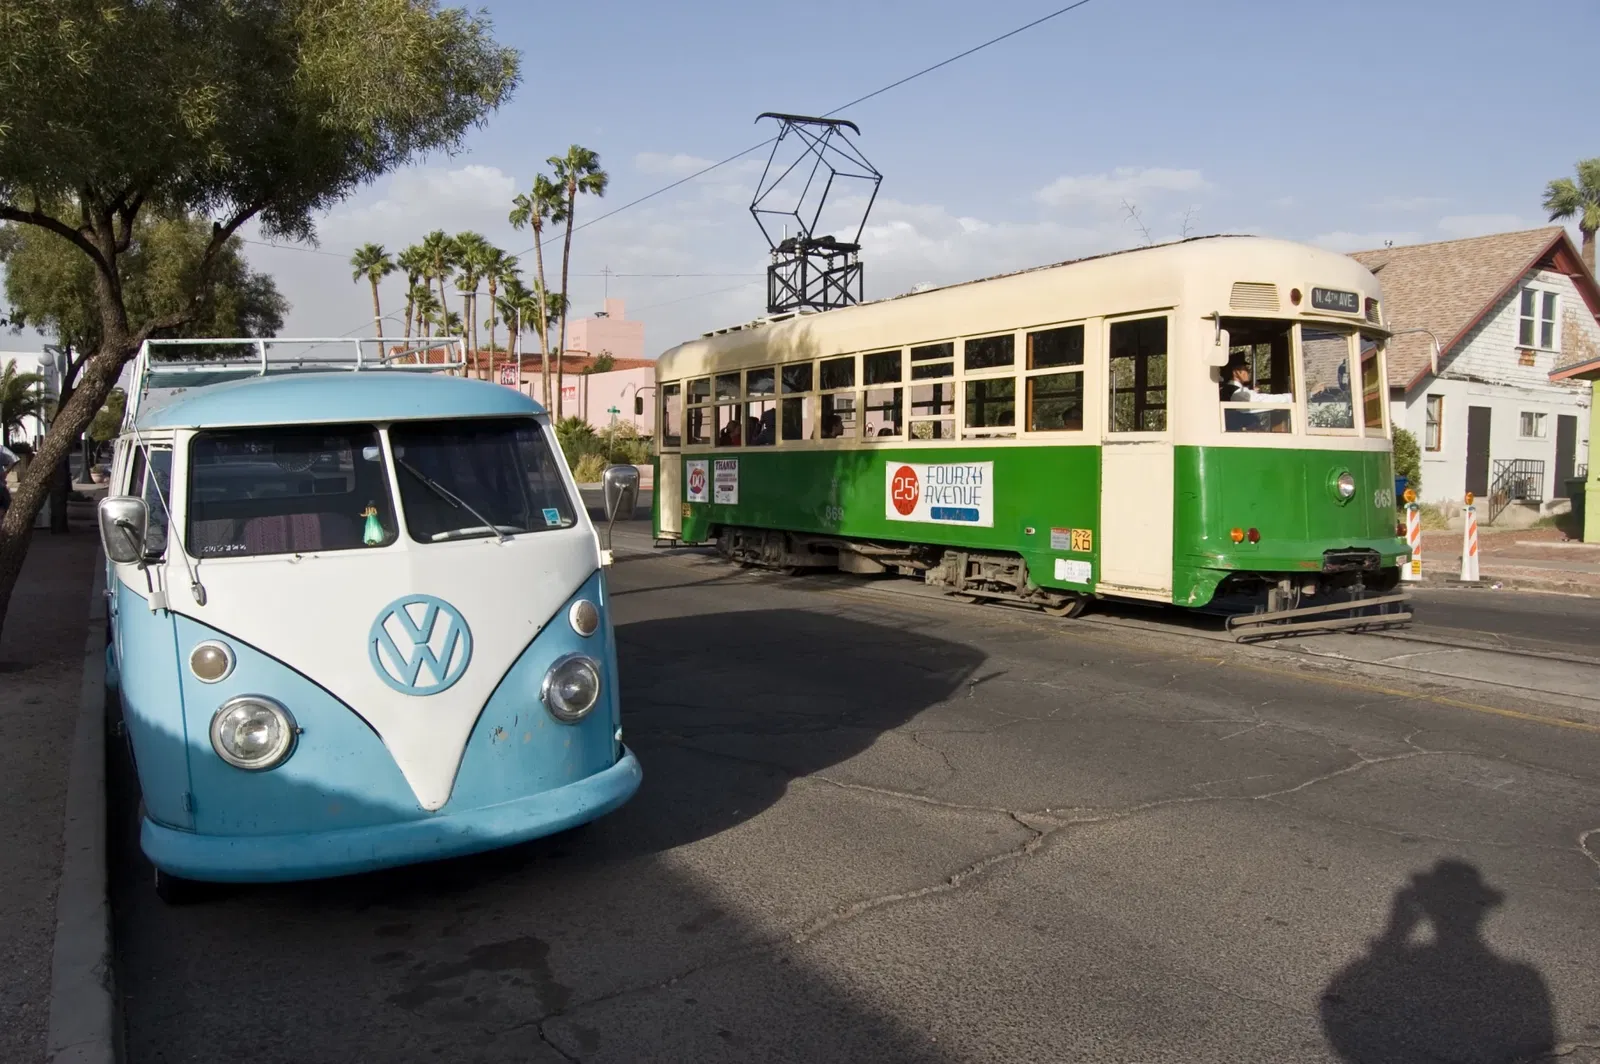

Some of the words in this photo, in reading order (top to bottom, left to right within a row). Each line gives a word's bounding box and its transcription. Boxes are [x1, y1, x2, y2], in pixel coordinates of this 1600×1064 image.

[1315, 290, 1324, 303] N.
[1325, 291, 1338, 304] 4TH
[1339, 293, 1356, 307] AVE.
[715, 460, 737, 470] THANKS
[692, 474, 704, 488] DQ
[926, 465, 983, 485] FOURTH
[924, 485, 982, 506] AVENUE
[1374, 488, 1391, 508] 869
[825, 505, 844, 521] 869
[1072, 538, 1091, 550] 入口
[368, 594, 474, 696] VW
